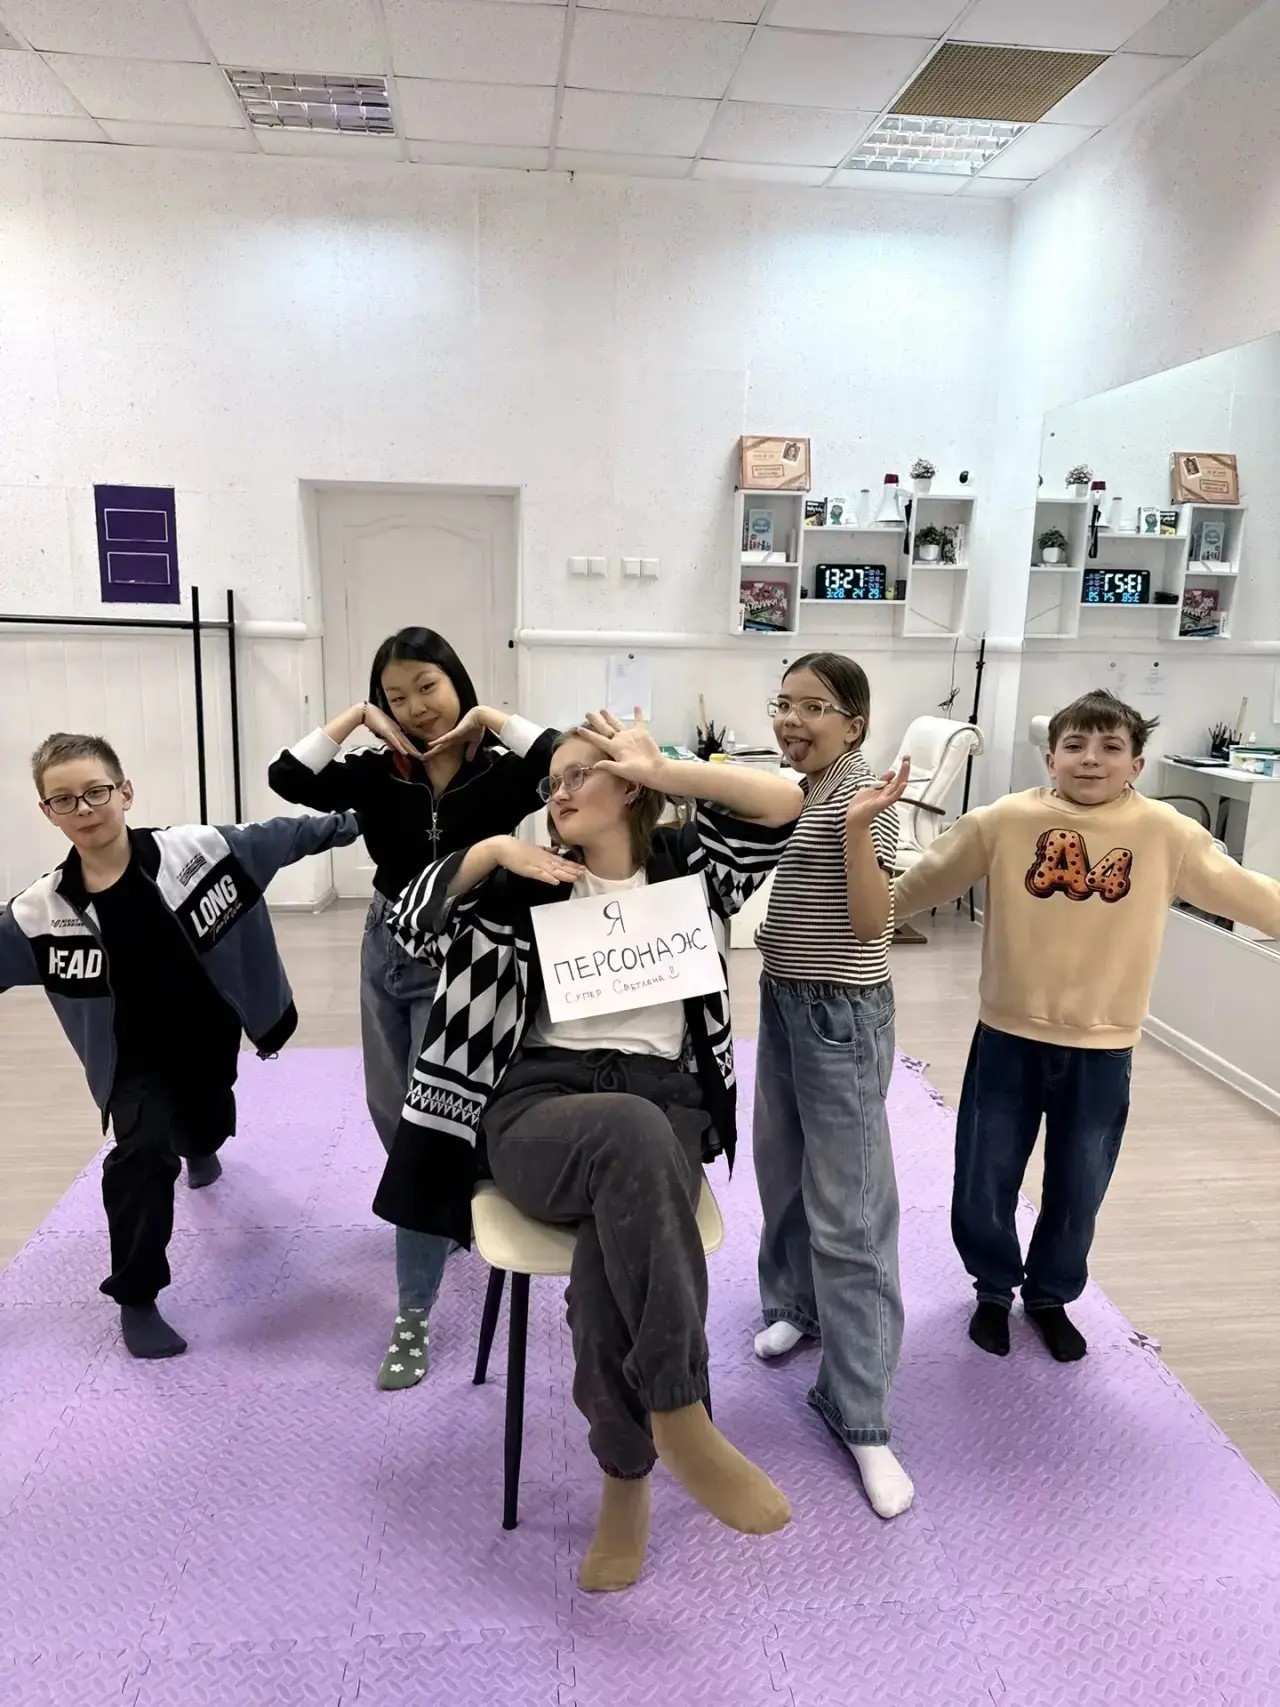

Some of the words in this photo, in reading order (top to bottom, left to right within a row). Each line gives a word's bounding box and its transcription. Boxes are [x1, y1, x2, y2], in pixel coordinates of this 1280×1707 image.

[825, 568, 864, 589] 13:27
[190, 874, 238, 938] LONG
[603, 900, 626, 936] Я
[48, 946, 102, 979] HEAD
[553, 927, 708, 985] ПЕРСОНАЖ
